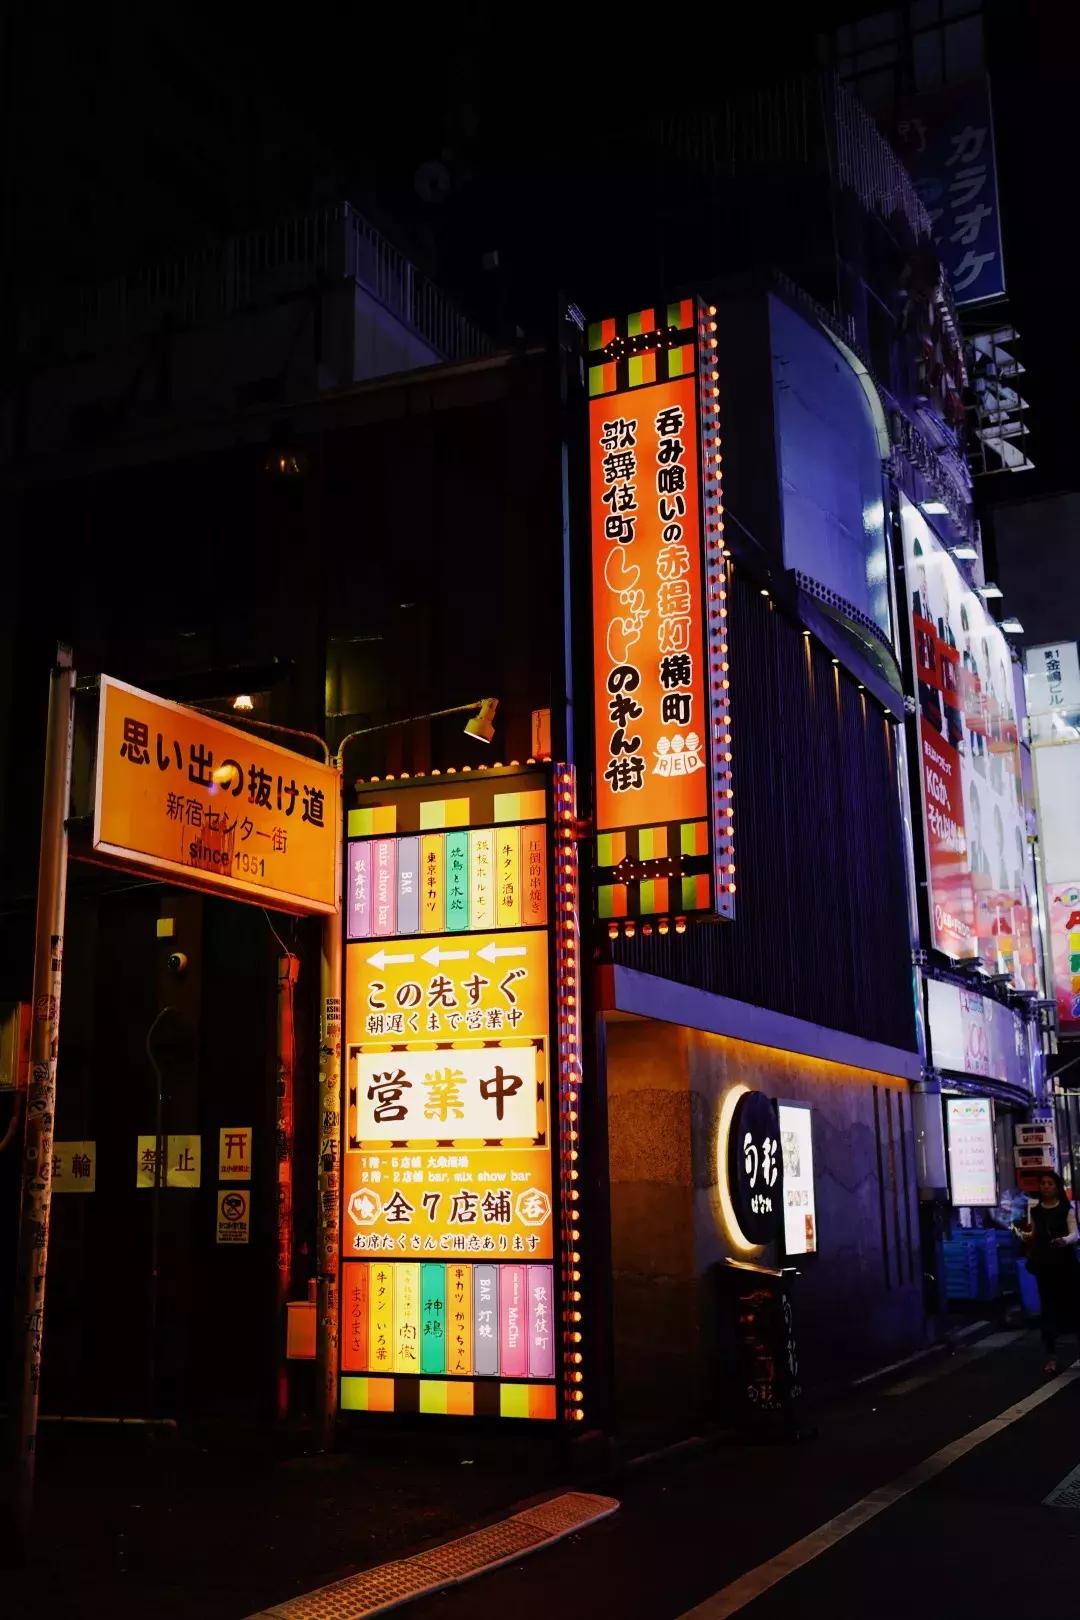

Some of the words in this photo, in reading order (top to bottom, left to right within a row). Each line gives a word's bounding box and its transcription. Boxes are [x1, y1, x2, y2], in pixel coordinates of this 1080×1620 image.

[945, 125, 995, 292] カラオケ
[654, 404, 694, 725] 呑み喰いの赤提灯横町
[601, 417, 647, 793] 歌舞伎町レッドのれん街
[120, 717, 325, 827] 思い出の抜け道
[658, 754, 697, 772] RED
[166, 792, 288, 854] 新宿センター街
[189, 840, 229, 865] since
[234, 852, 265, 877] 1951
[502, 844, 513, 907] 牛タン酒場
[401, 871, 412, 895] BAR
[427, 852, 436, 911] 東京串カツ
[477, 841, 488, 919] 鉄板ホルモン
[368, 969, 527, 1009] この先すぐ
[367, 1008, 524, 1034] 朝遅くまで営業中
[367, 1065, 523, 1124] 営業中
[142, 1148, 195, 1173] 禁止
[477, 1171, 507, 1182] show
[511, 1170, 531, 1182] bar
[743, 1132, 777, 1188] 旬彩
[353, 1235, 540, 1251] お席たくさんご用意あります
[377, 1271, 387, 1310] 牛タン
[455, 1268, 464, 1302] 串カツ
[480, 1279, 491, 1301] BAR
[424, 1296, 443, 1338] 神鶏
[534, 1286, 548, 1349] 歌舞伎町
[376, 1323, 387, 1360] いろ葉
[455, 1312, 465, 1370] かっちゃん
